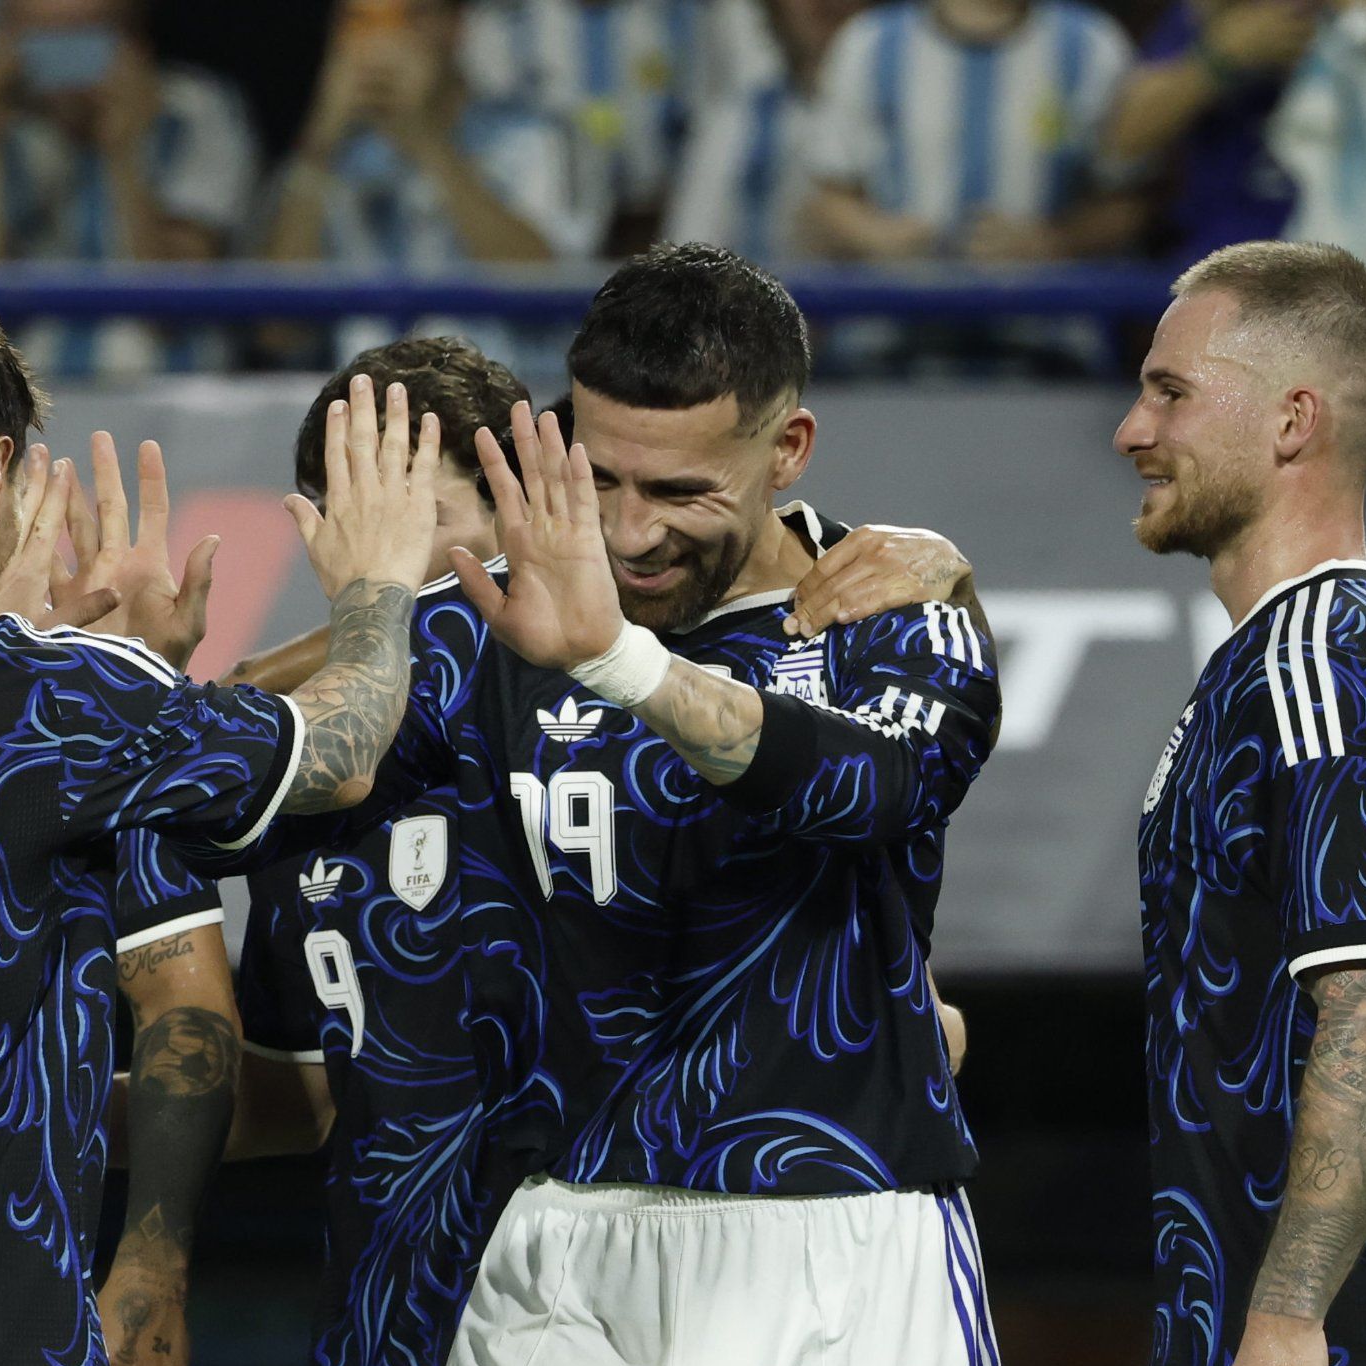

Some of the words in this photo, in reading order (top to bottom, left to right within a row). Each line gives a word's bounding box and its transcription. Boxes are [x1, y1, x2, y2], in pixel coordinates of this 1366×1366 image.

[406, 873, 431, 886] FIFA
[510, 771, 616, 906] 19
[304, 930, 365, 1059] 9
